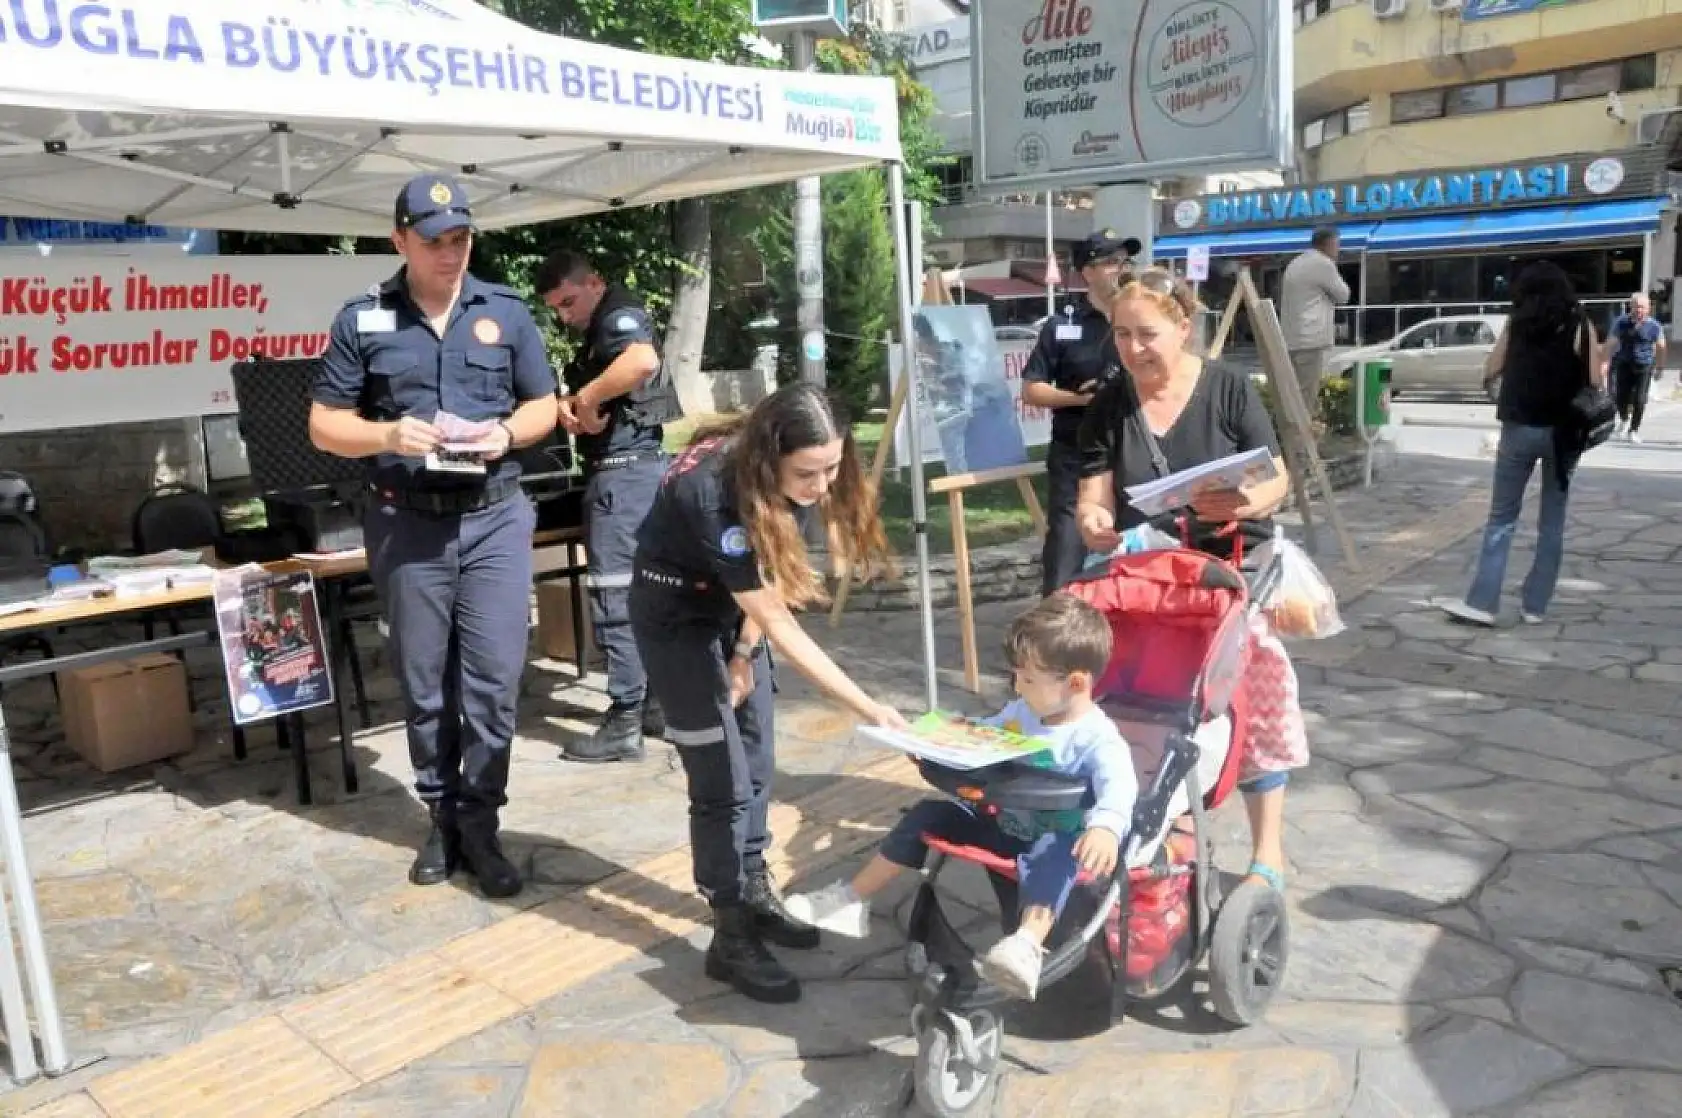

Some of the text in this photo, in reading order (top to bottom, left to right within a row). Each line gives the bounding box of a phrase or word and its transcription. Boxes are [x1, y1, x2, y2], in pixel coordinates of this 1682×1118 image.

[1022, 0, 1092, 46] Aile
[0, 0, 205, 63] UĞLA
[220, 15, 550, 96] BÜYÜKŞEHİR
[560, 60, 764, 122] BELEDİYESİ
[1023, 41, 1103, 68] Geçmişten
[1024, 61, 1117, 93] Geleceğe bir
[1024, 92, 1098, 121] Köprüdür
[1207, 184, 1337, 227] BULVAR
[1343, 162, 1571, 214] LOKANTASI
[2, 266, 268, 326] Küçük İhmaller,
[51, 329, 198, 372] Sorunlar
